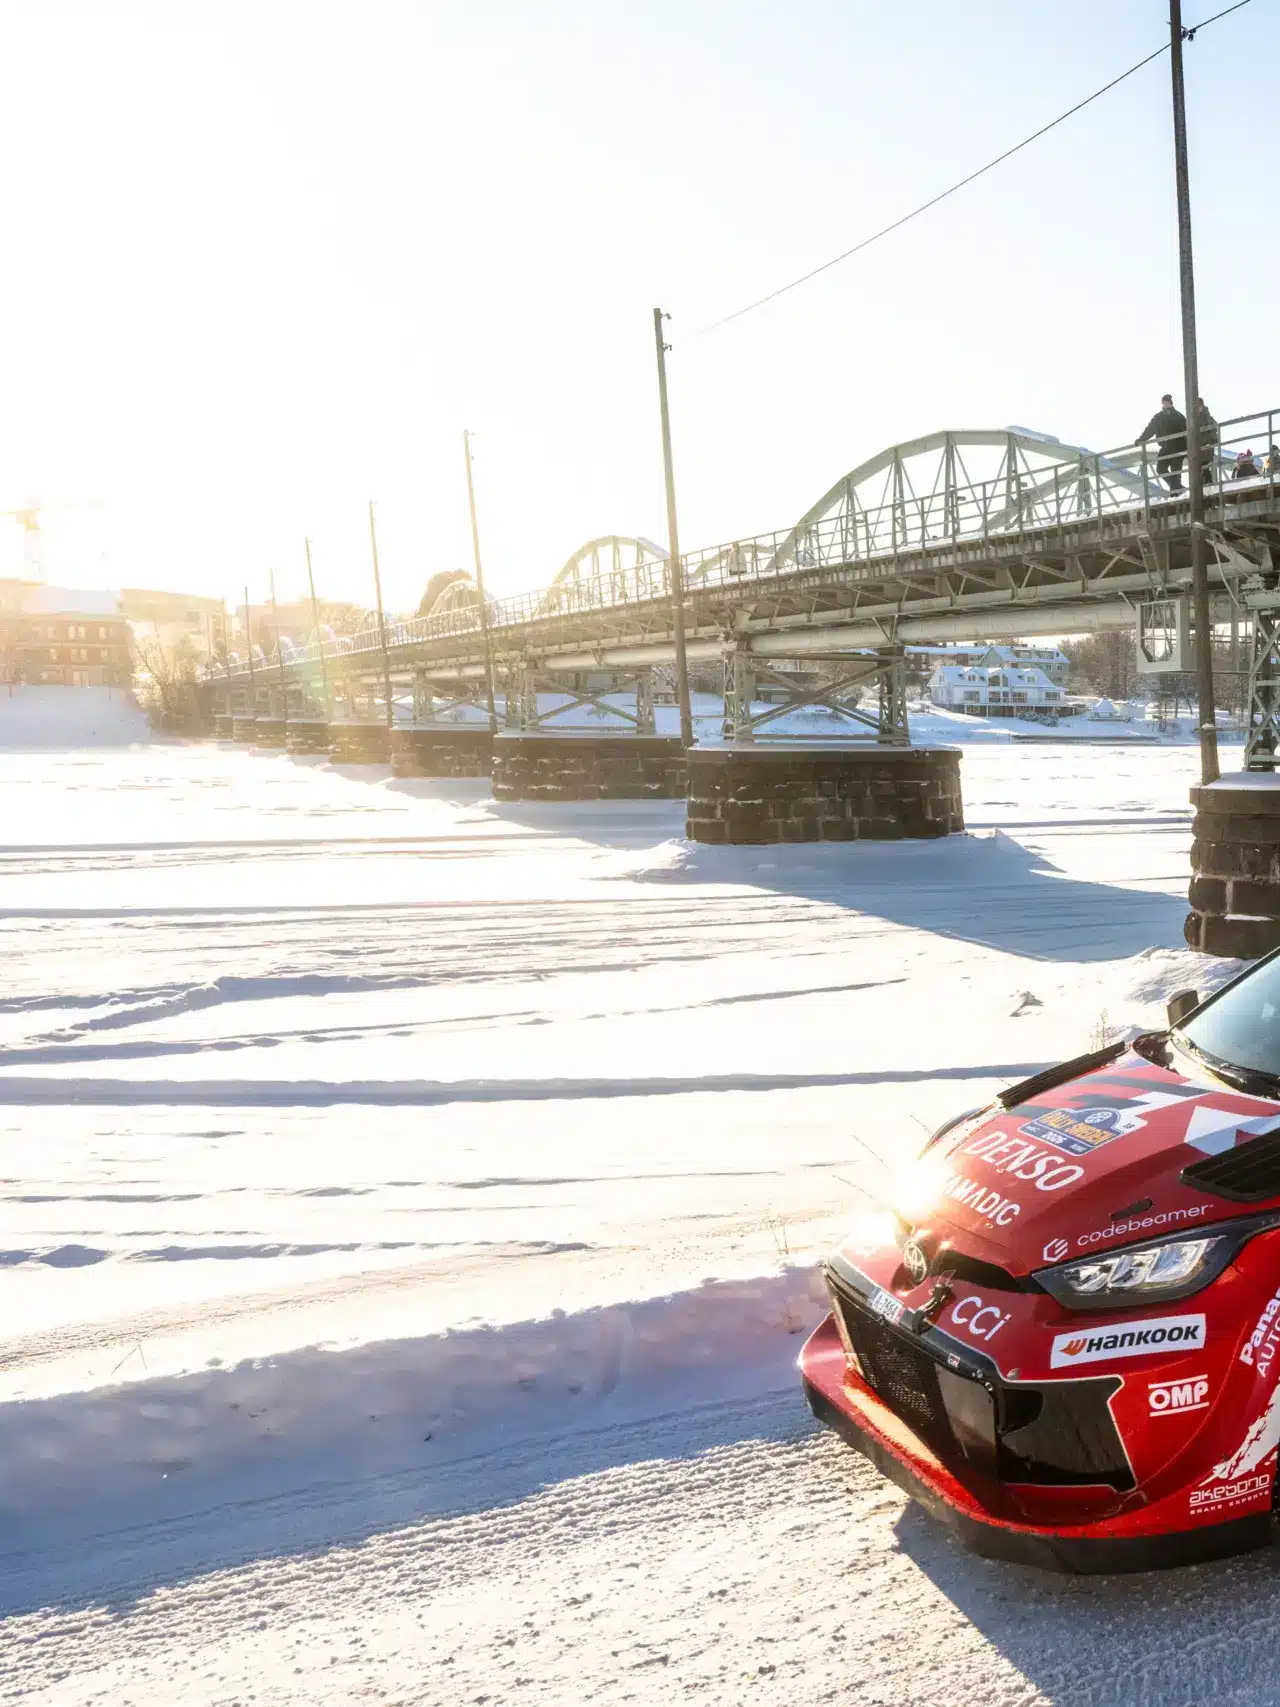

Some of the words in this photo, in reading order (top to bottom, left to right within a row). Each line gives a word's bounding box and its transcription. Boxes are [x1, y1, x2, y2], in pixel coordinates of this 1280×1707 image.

[962, 1130, 1085, 1192] DENSO
[1077, 1204, 1209, 1247] codebeamer
[1149, 1380, 1209, 1411] OMP
[1189, 1474, 1270, 1504] akebono
